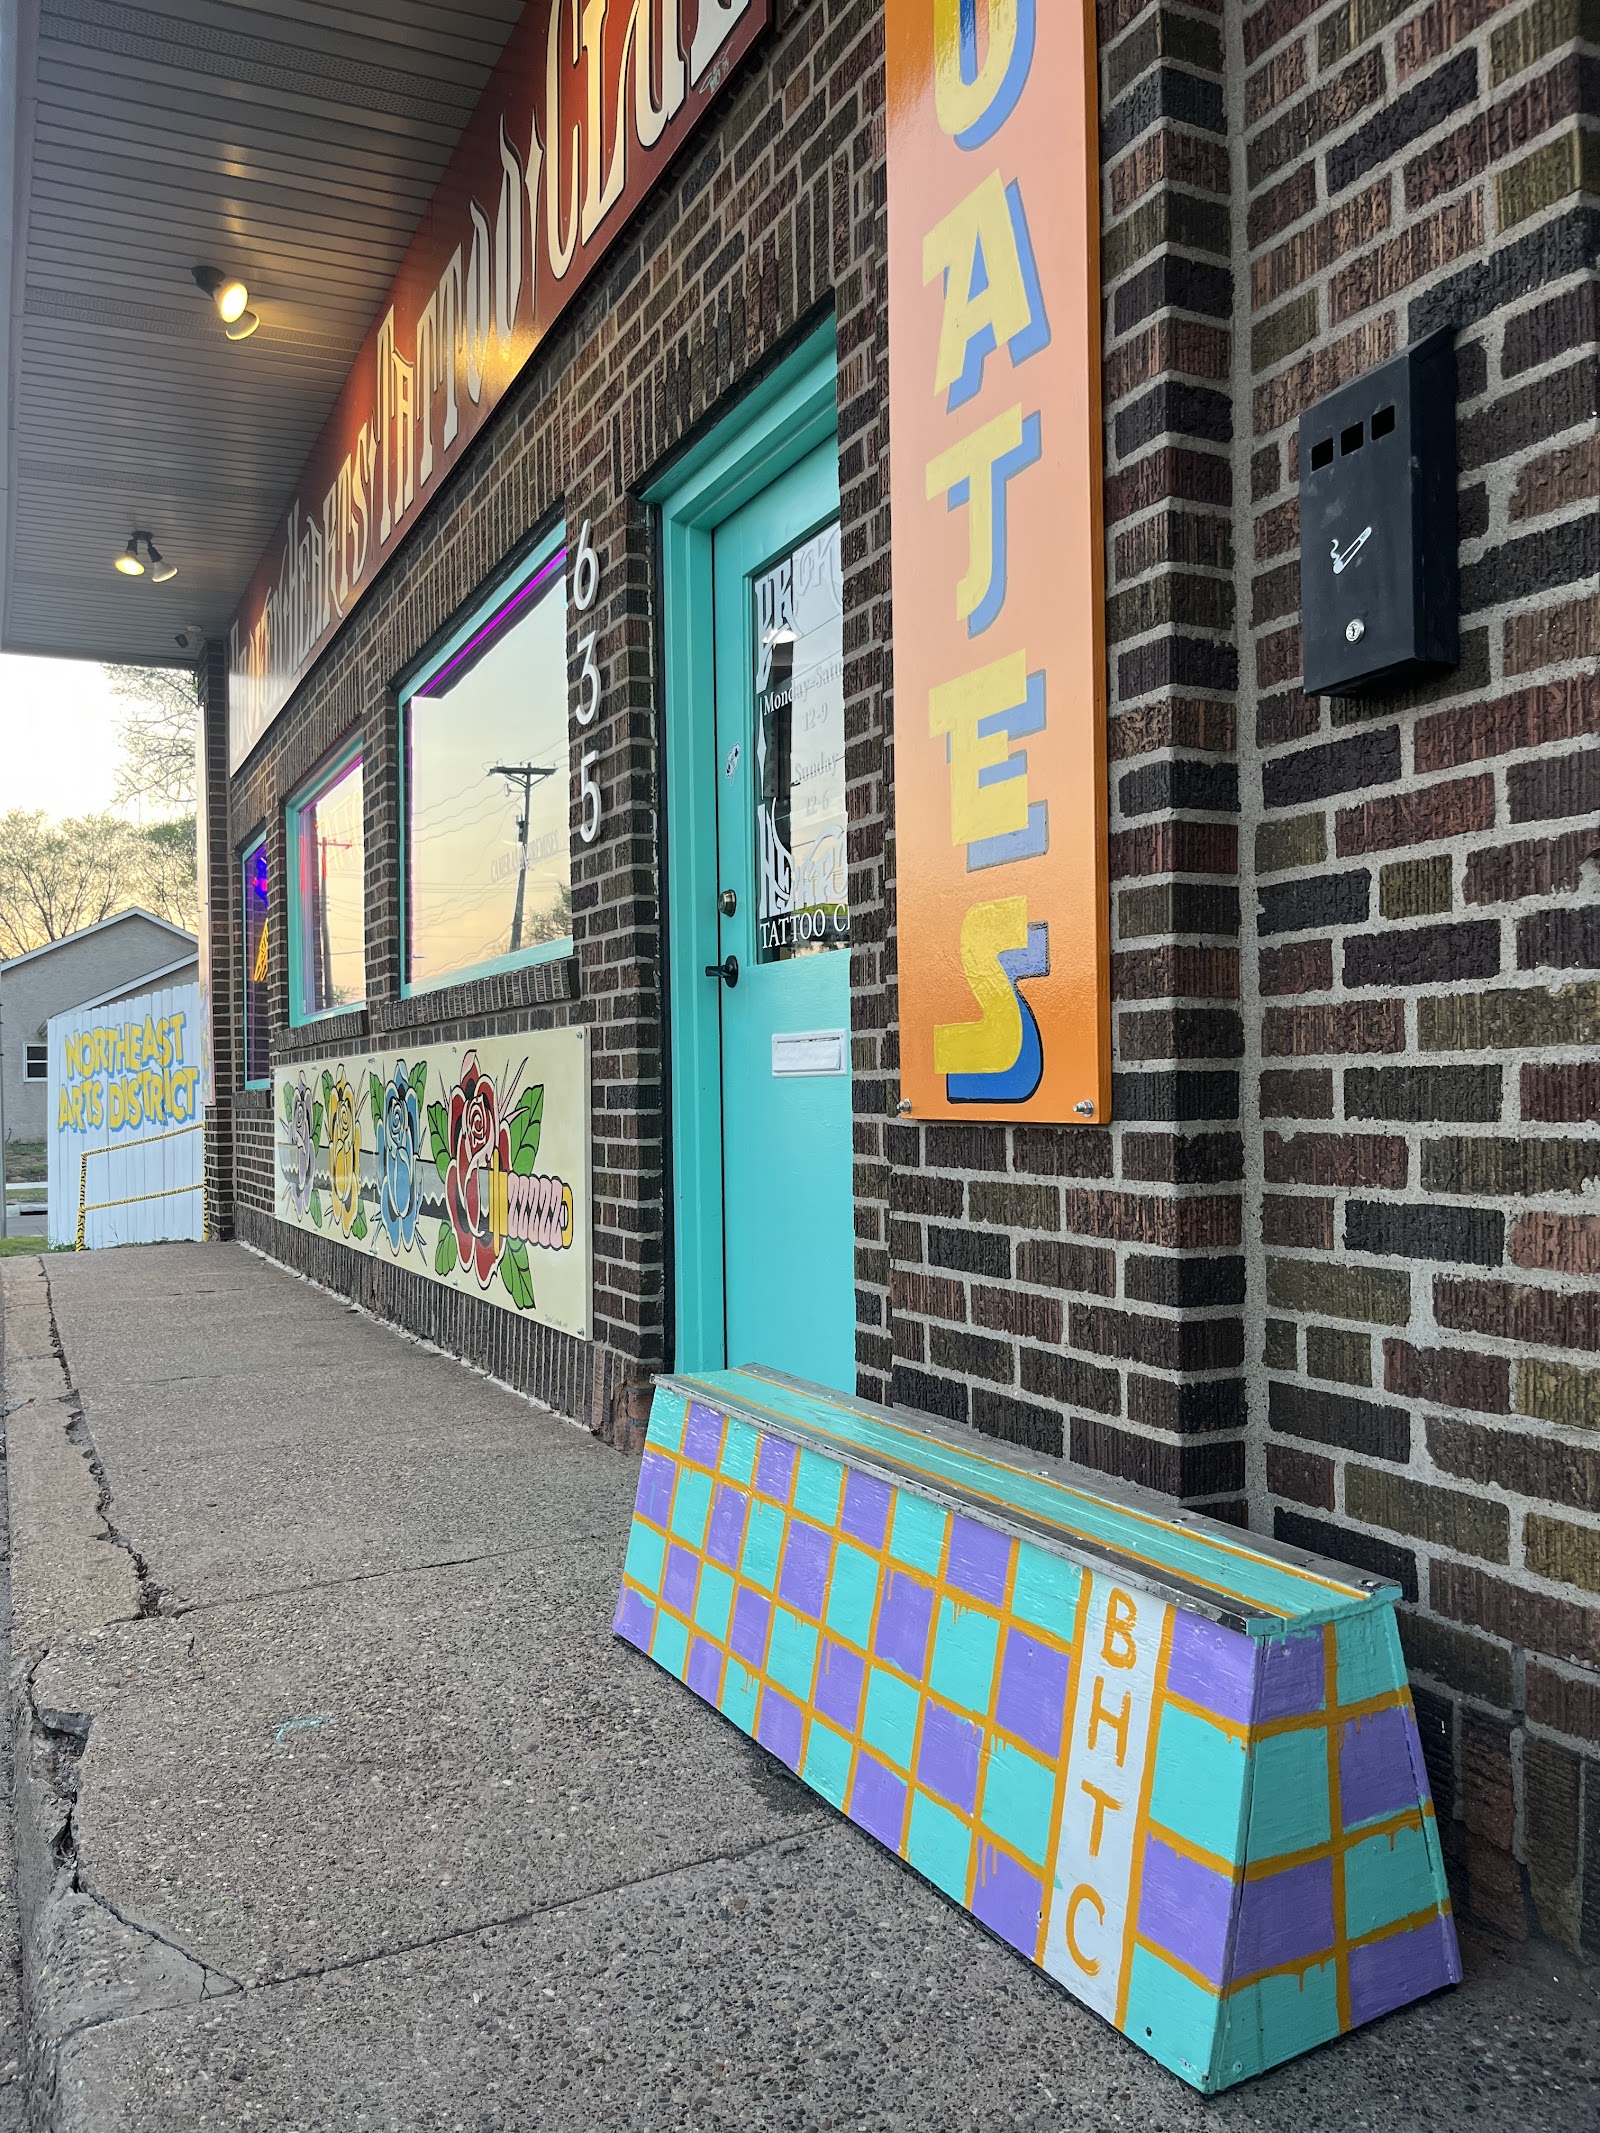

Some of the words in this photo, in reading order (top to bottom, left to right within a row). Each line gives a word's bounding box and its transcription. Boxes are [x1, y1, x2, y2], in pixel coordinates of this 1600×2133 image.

[287, 421, 369, 674] HEARTS
[377, 112, 521, 546] TATTOO
[547, 0, 750, 279] CLU
[573, 518, 603, 844] 635
[760, 908, 825, 949] TATTOO
[57, 1077, 104, 1134] ARTS
[108, 1065, 200, 1132] DISTRICT
[64, 1011, 187, 1081] NORTHEAST
[1065, 1587, 1138, 1978] BHTC
